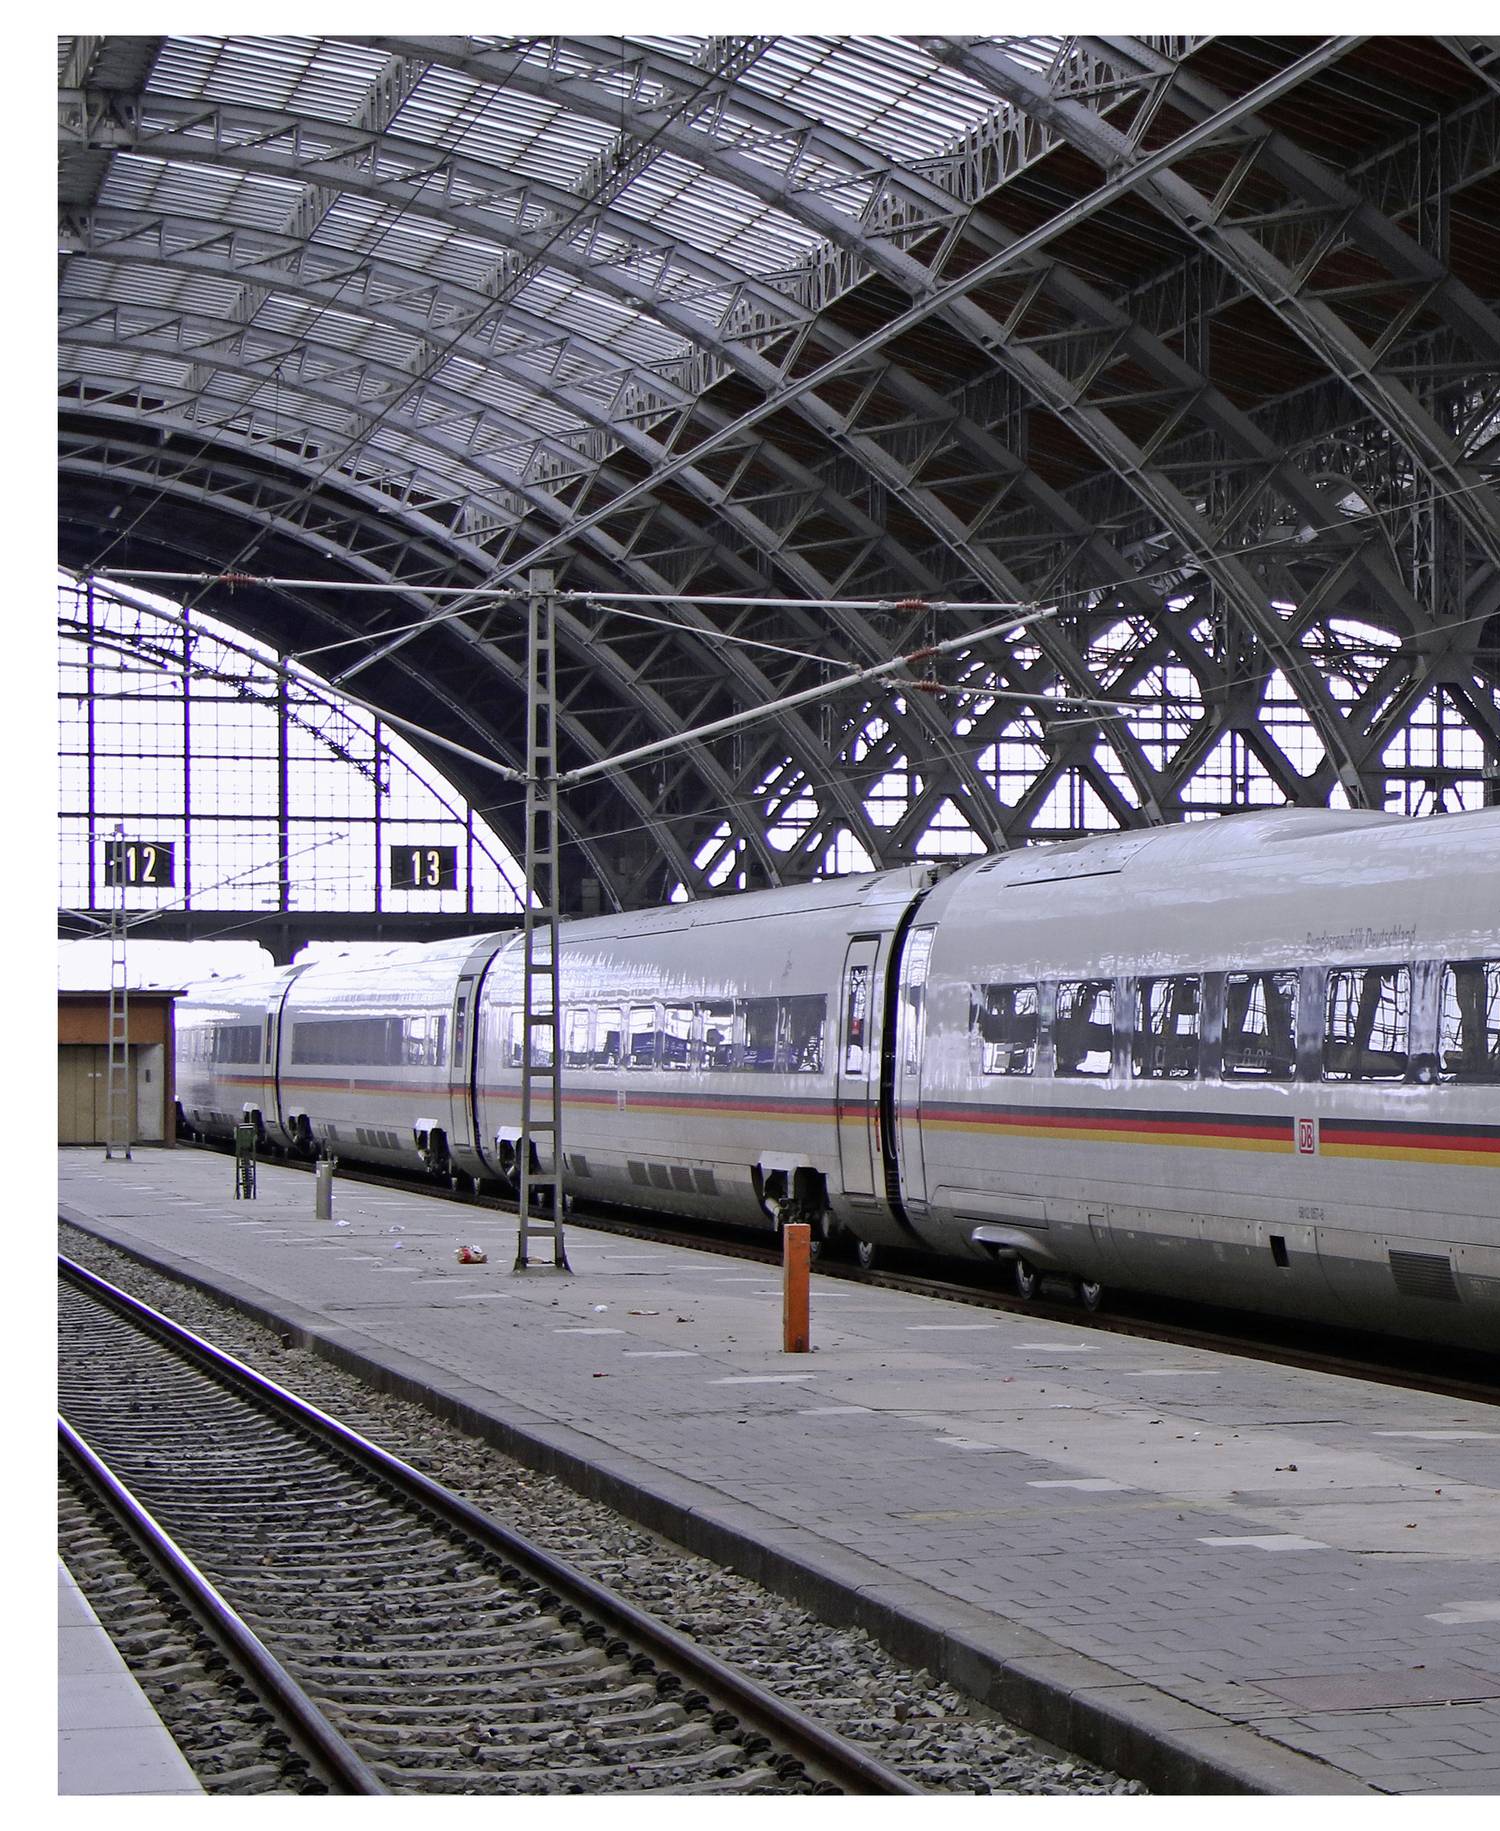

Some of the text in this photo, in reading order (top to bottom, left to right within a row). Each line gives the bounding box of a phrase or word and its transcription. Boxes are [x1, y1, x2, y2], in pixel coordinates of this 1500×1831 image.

[127, 846, 156, 882] 12
[412, 850, 440, 886] 13
[1300, 1122, 1314, 1150] DB
